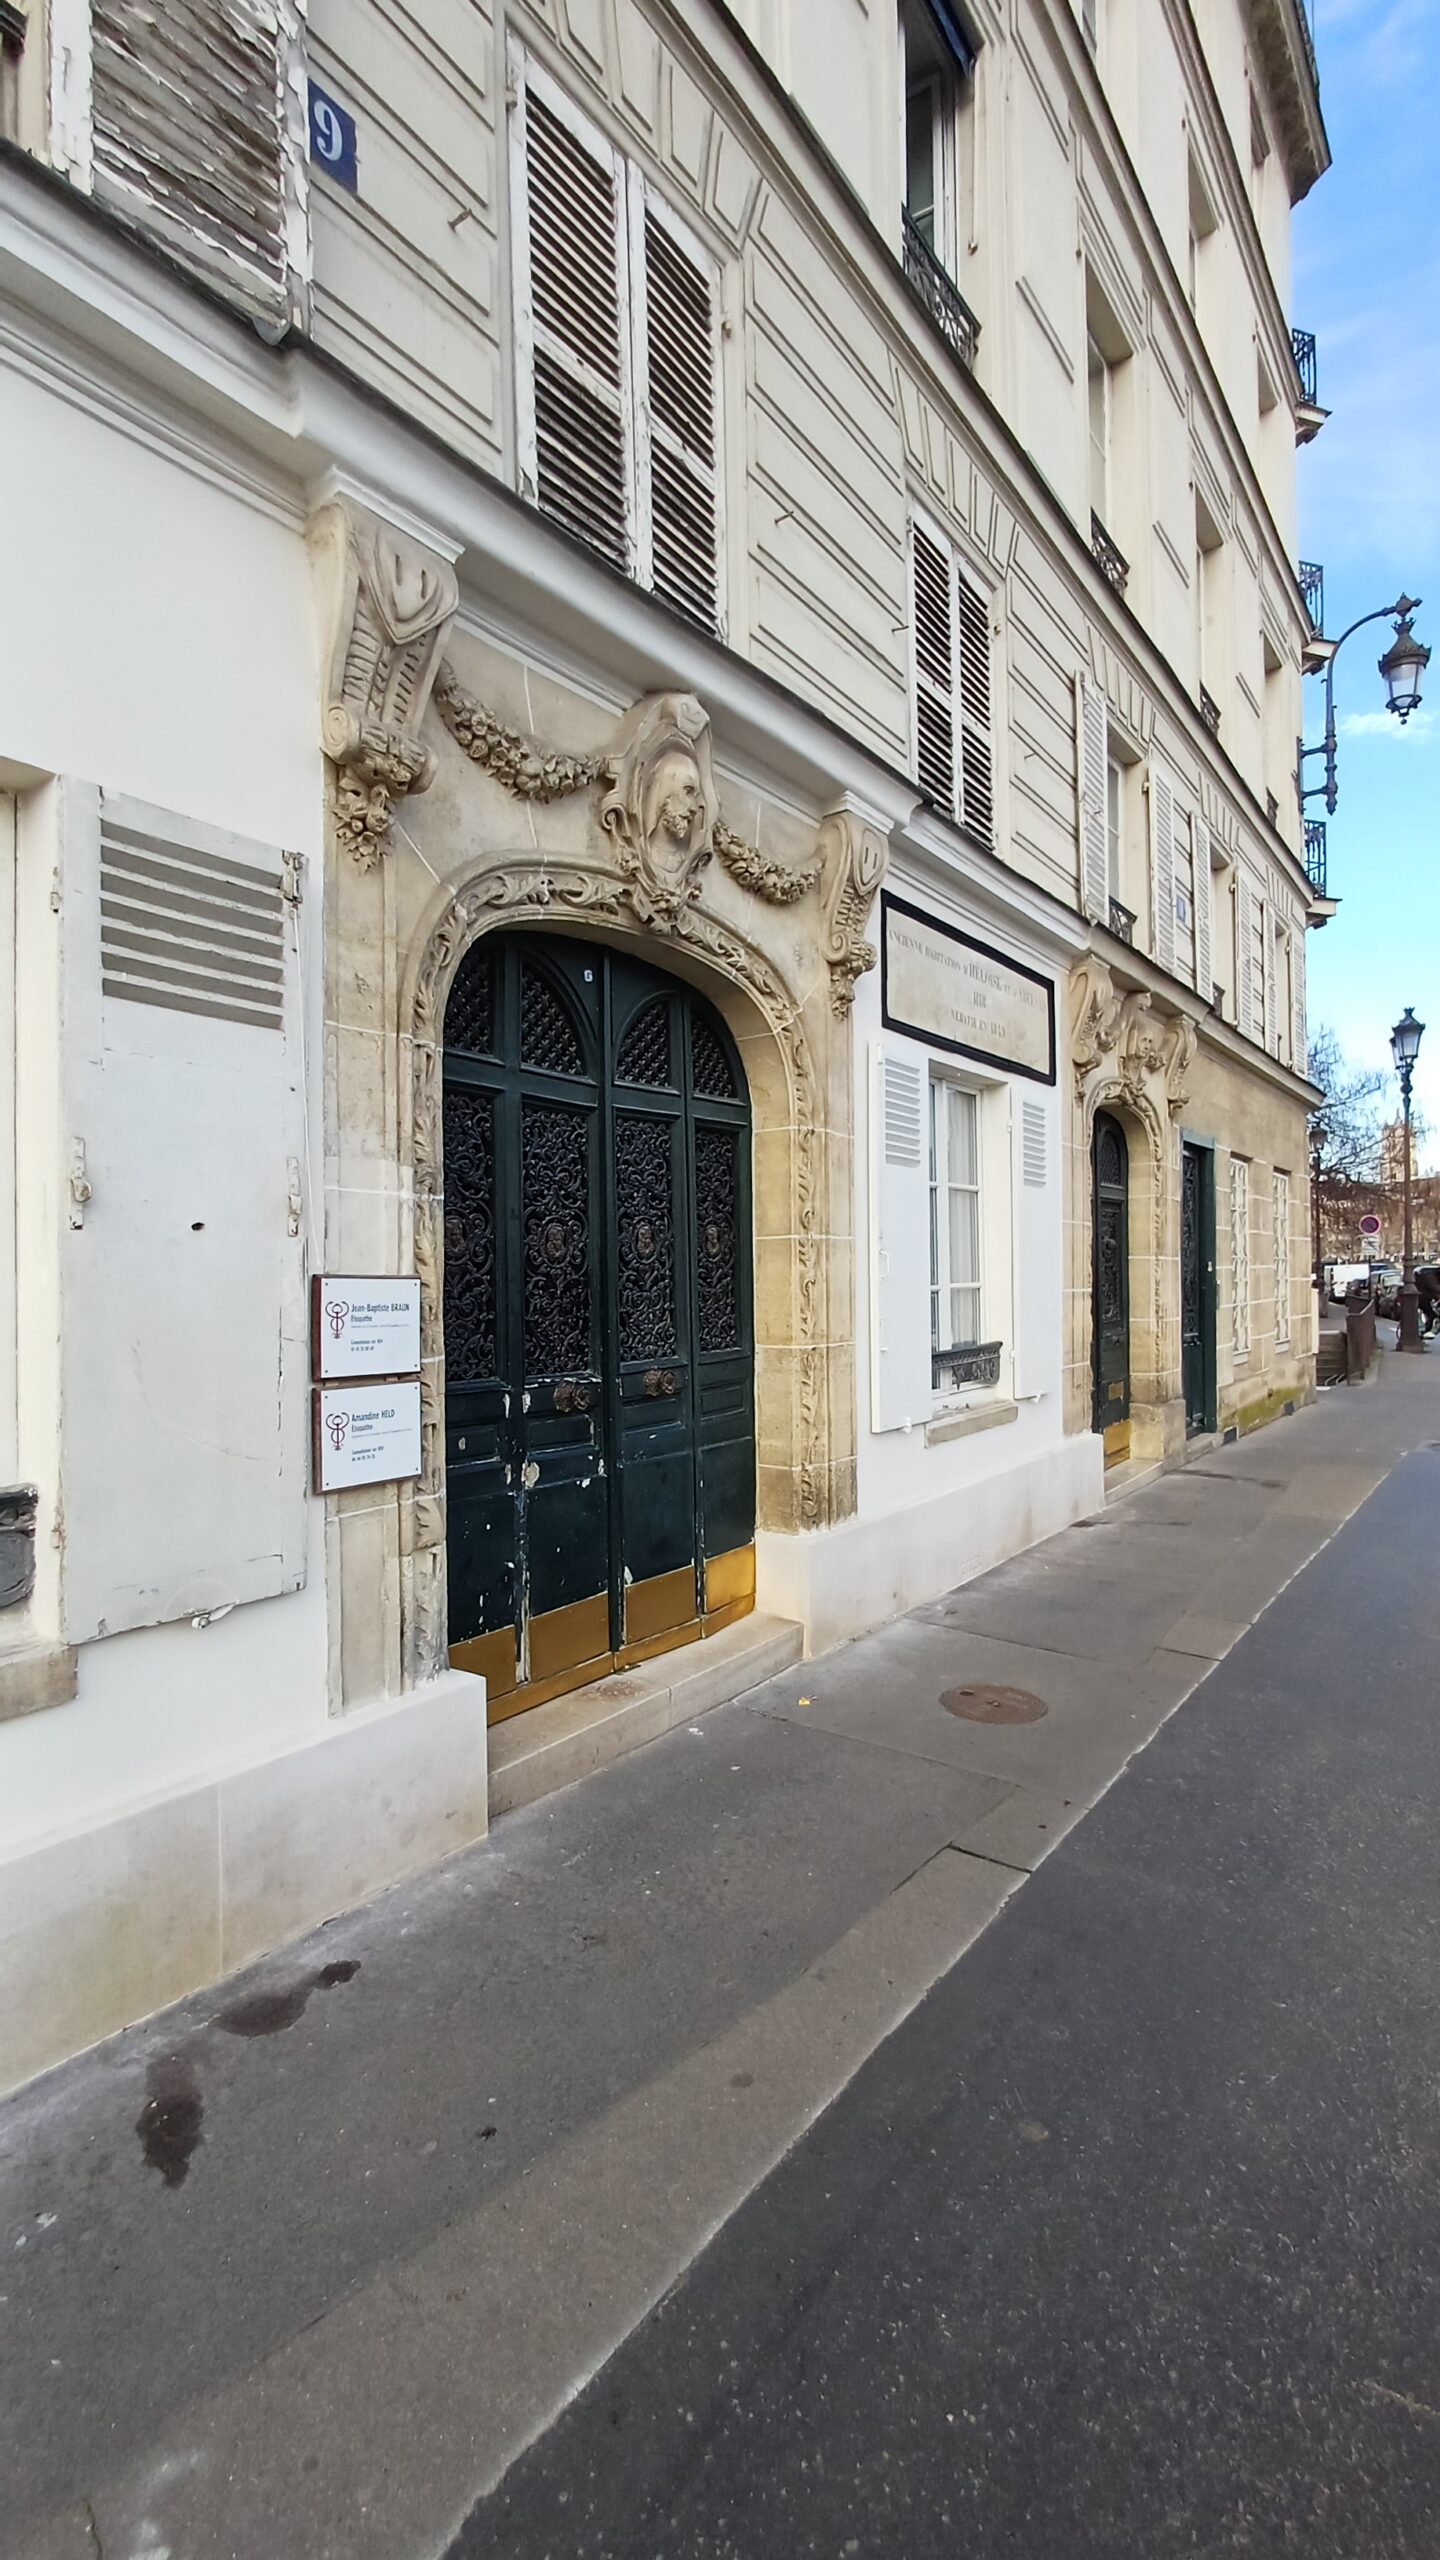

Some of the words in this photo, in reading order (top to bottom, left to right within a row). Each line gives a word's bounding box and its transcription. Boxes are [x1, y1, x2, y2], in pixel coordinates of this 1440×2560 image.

[314, 100, 342, 161] 9
[351, 1303, 389, 1314] Jean-Baptiste
[391, 1303, 410, 1312] BRAUN
[352, 1411, 380, 1422] Amandine
[381, 1408, 396, 1418] HELD
